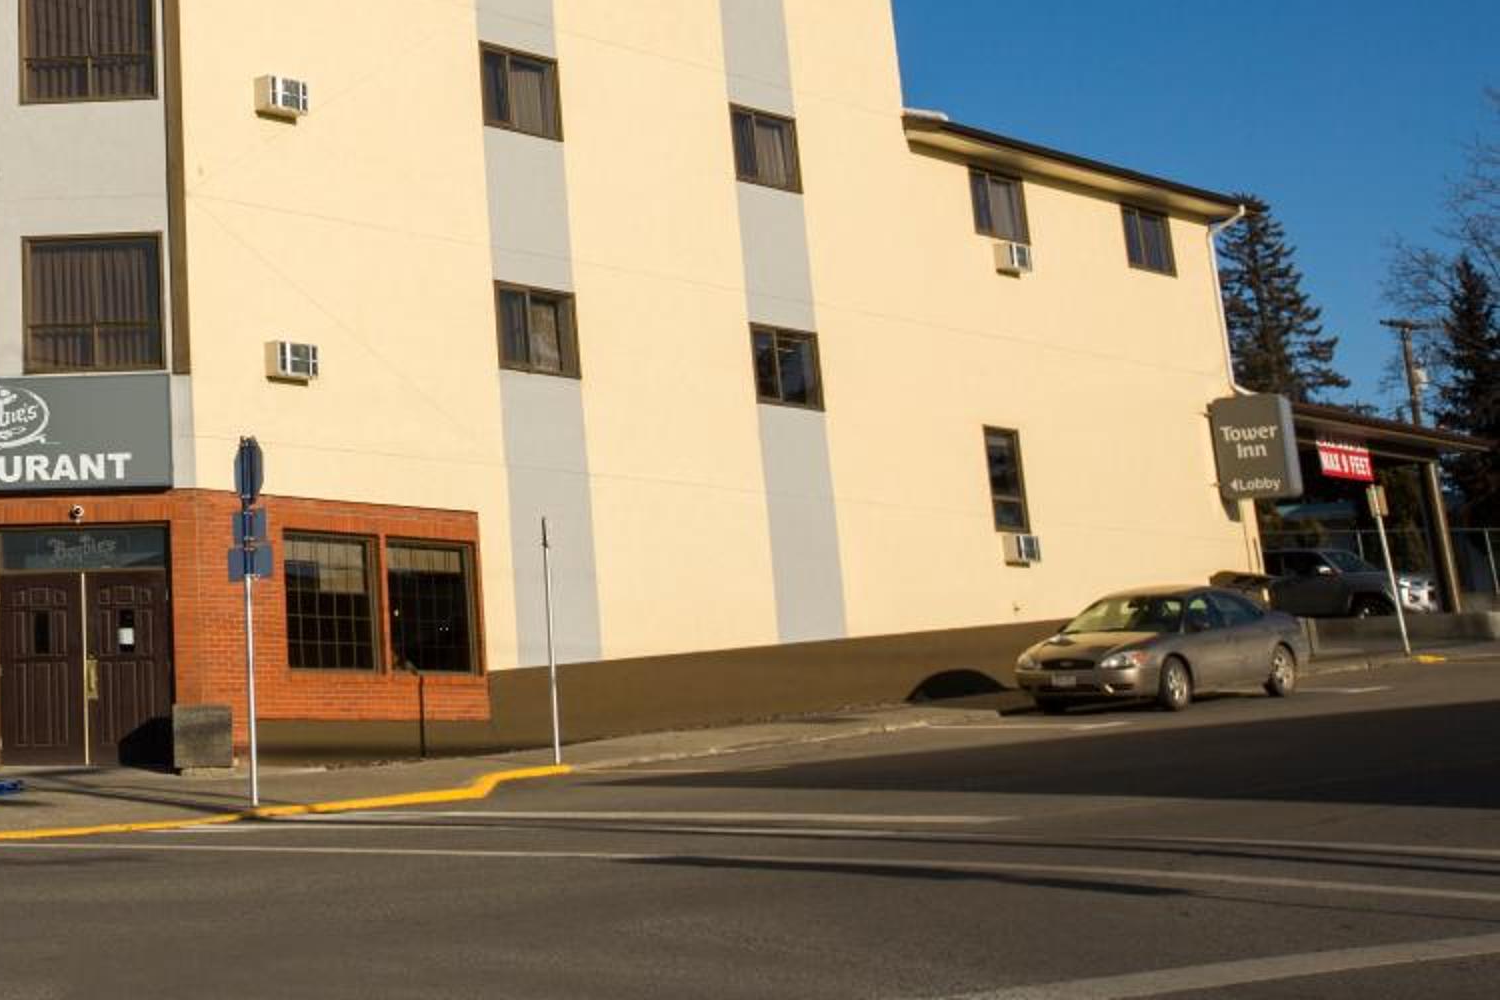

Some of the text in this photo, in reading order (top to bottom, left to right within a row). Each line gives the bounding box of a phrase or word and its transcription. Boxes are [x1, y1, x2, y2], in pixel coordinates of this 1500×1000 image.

[1220, 425, 1278, 442] Tower
[1236, 443, 1268, 459] Inn
[1239, 477, 1281, 491] Lobby
